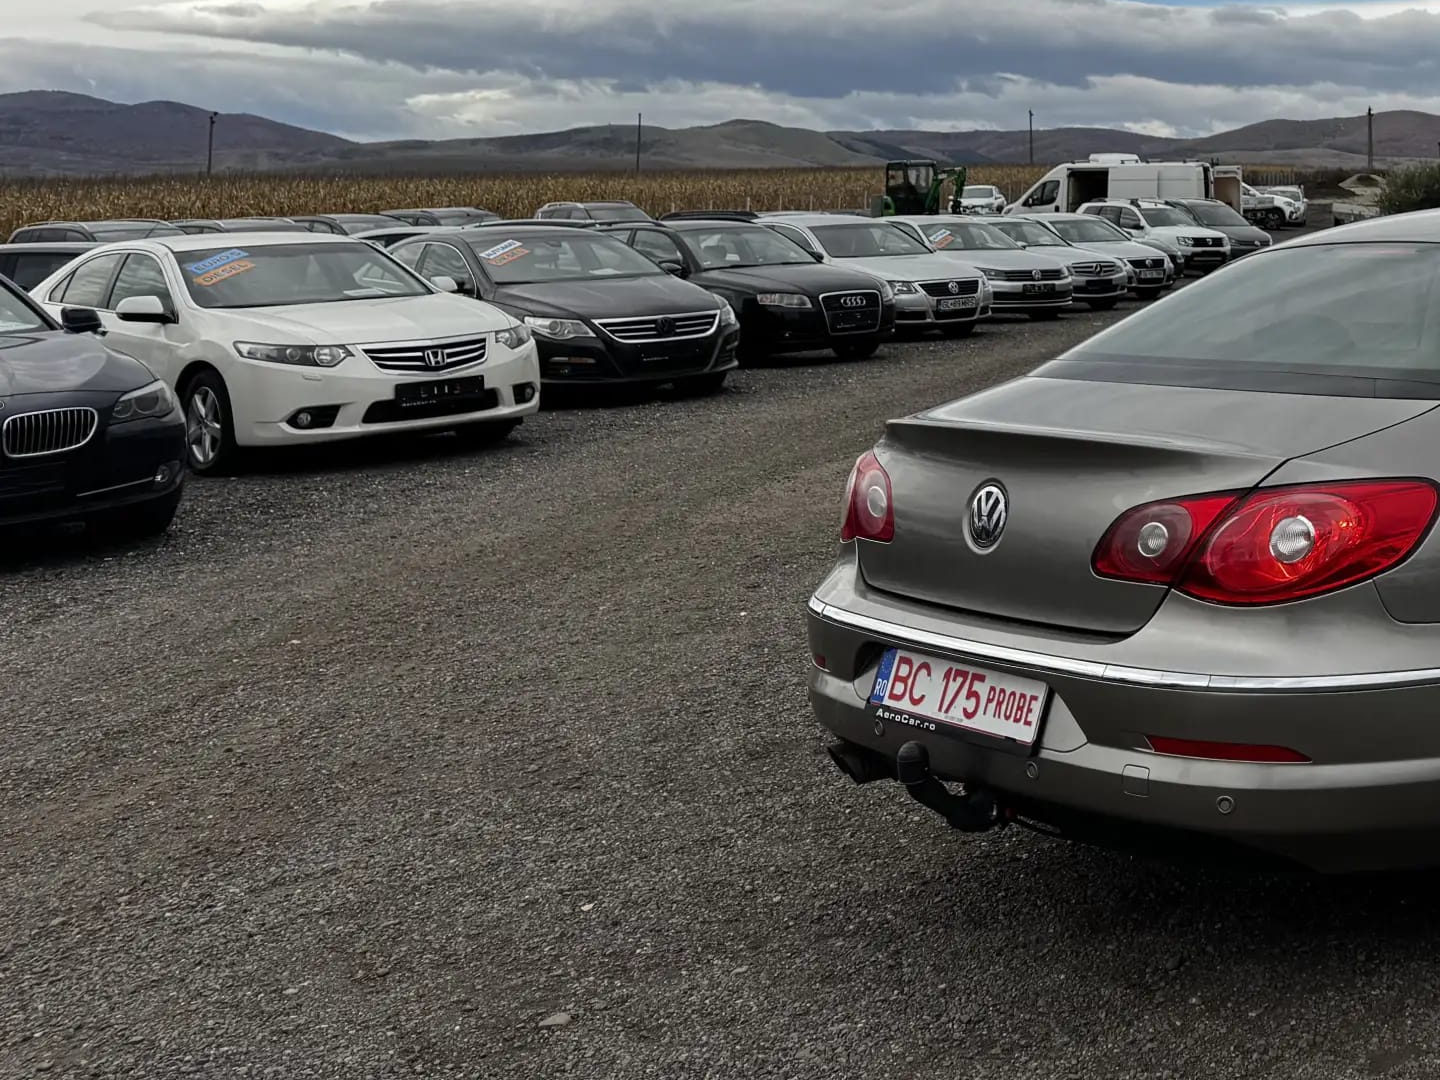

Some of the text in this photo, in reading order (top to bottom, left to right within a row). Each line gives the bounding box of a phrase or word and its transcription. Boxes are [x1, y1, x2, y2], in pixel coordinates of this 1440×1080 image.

[874, 678, 888, 697] RO
[888, 656, 1039, 727] BC 175 PROBE
[876, 708, 936, 731] AeroCar.ro
